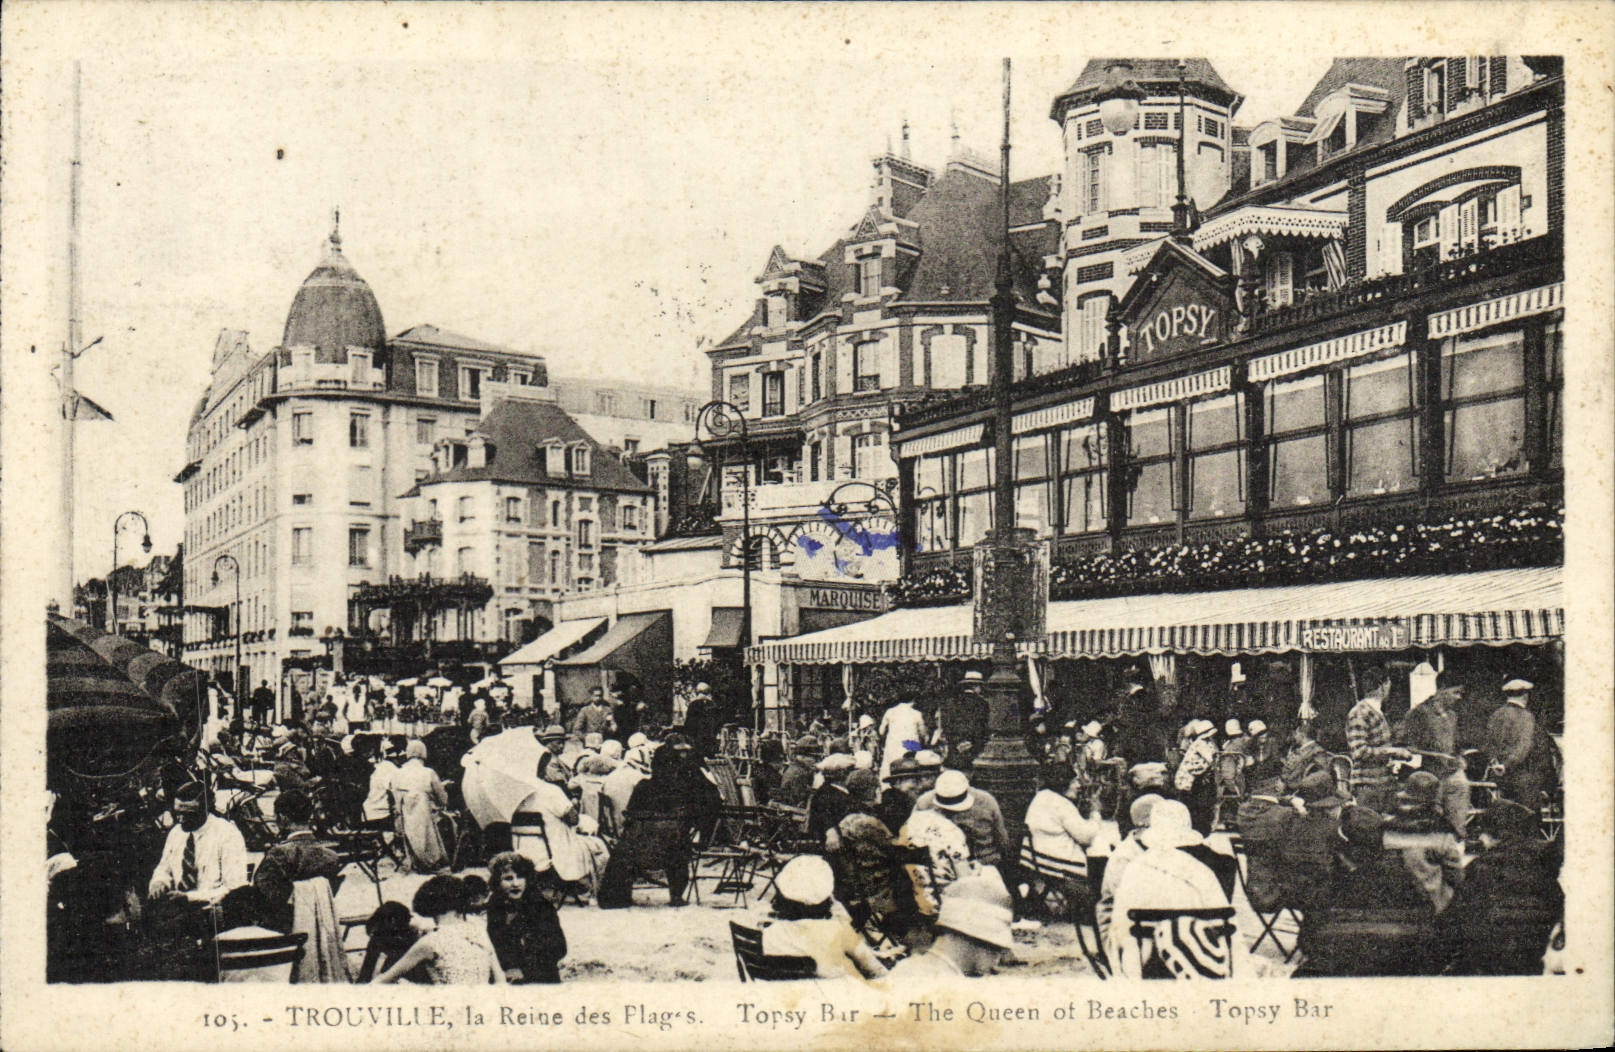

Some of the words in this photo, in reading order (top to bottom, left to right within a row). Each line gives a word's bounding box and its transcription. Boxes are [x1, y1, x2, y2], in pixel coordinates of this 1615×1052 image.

[1140, 304, 1215, 353] TOPSY
[809, 589, 880, 609] MARQUISE
[1302, 626, 1379, 649] RESTAURANT
